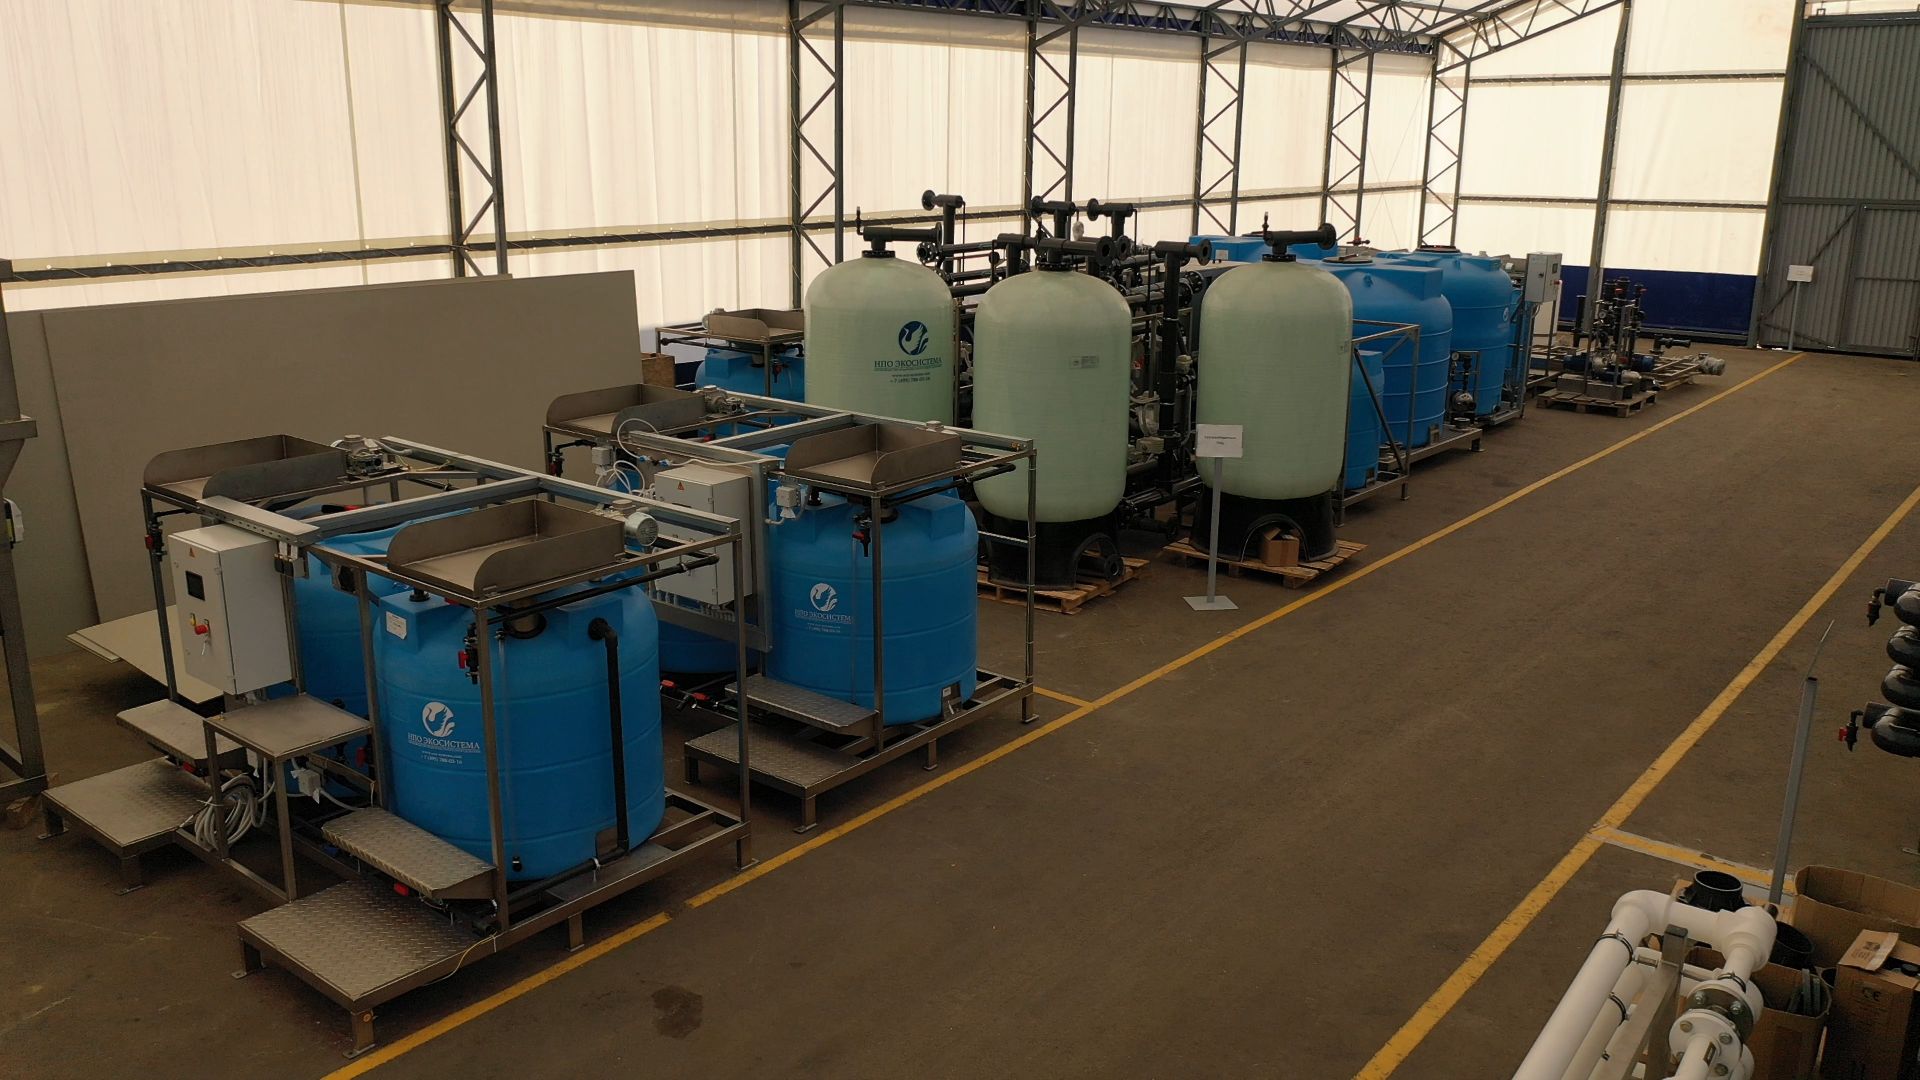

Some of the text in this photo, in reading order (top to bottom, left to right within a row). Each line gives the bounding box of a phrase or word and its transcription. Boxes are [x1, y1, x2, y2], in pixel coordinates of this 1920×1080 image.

[874, 357, 942, 368] НПО ЭКОСИСТЕМА
[809, 612, 853, 621] ЭКОСИСТЕМ
[407, 732, 423, 743] НПО
[424, 737, 480, 749] ЭКОСИСТЕМА
